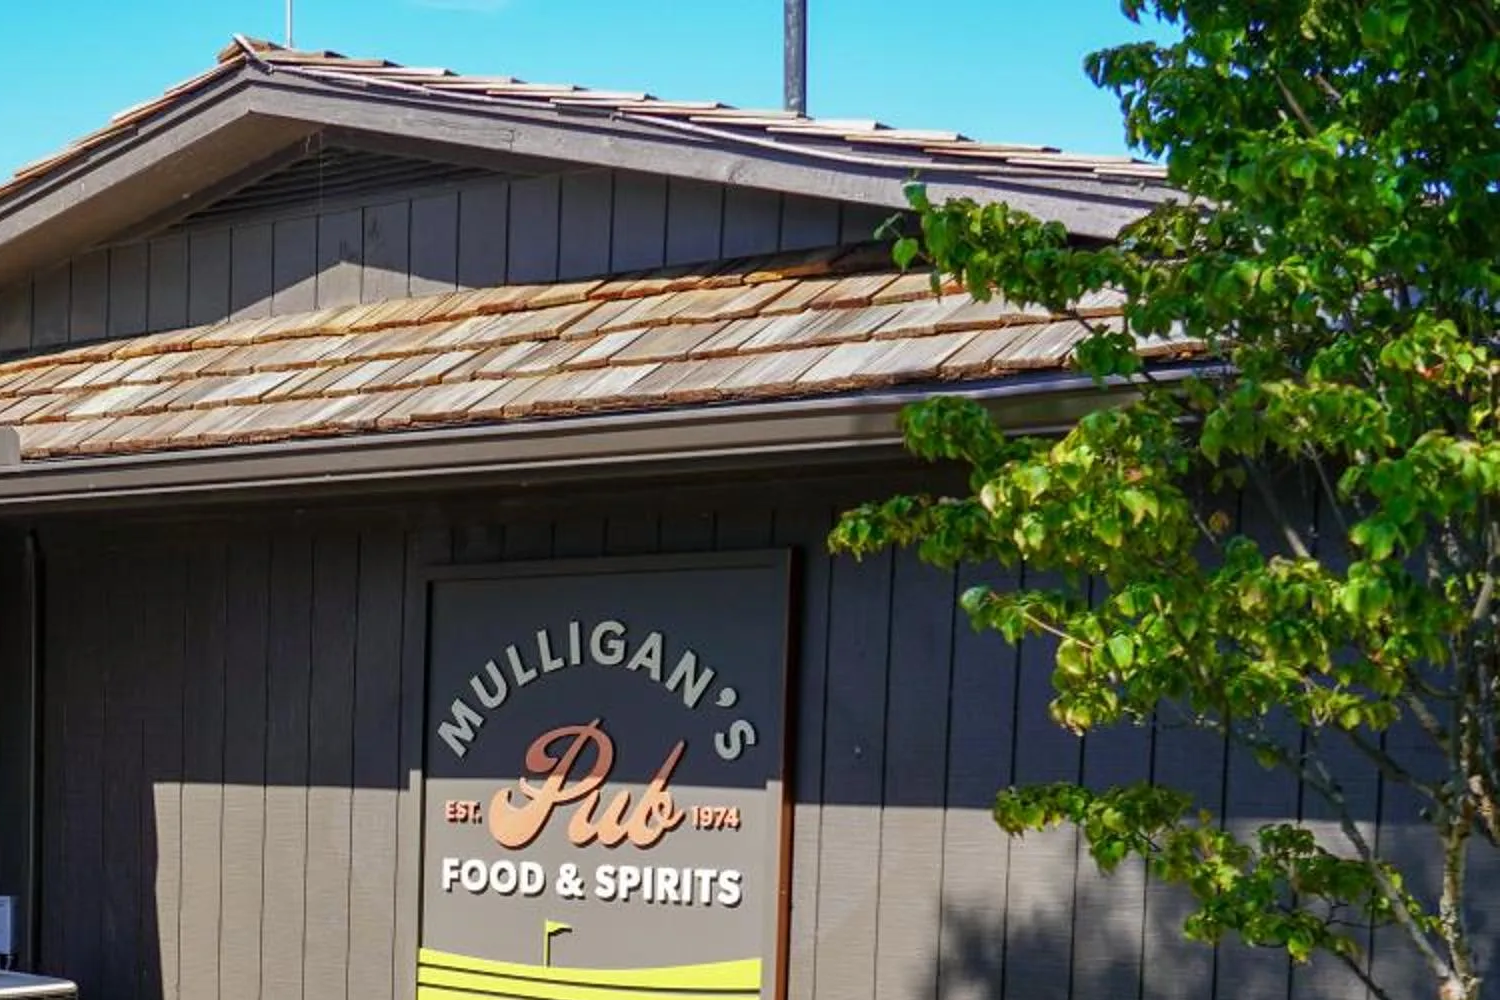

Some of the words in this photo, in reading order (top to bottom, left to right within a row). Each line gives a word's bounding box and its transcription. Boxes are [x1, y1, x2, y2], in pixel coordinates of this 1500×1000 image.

[437, 620, 756, 759] MULLIGAN'S
[445, 800, 481, 821] EST.
[691, 805, 740, 828] 1974
[488, 719, 685, 848] Pub
[441, 858, 546, 894] FOOD
[556, 864, 585, 898] &
[595, 865, 743, 906] SPIRITS
